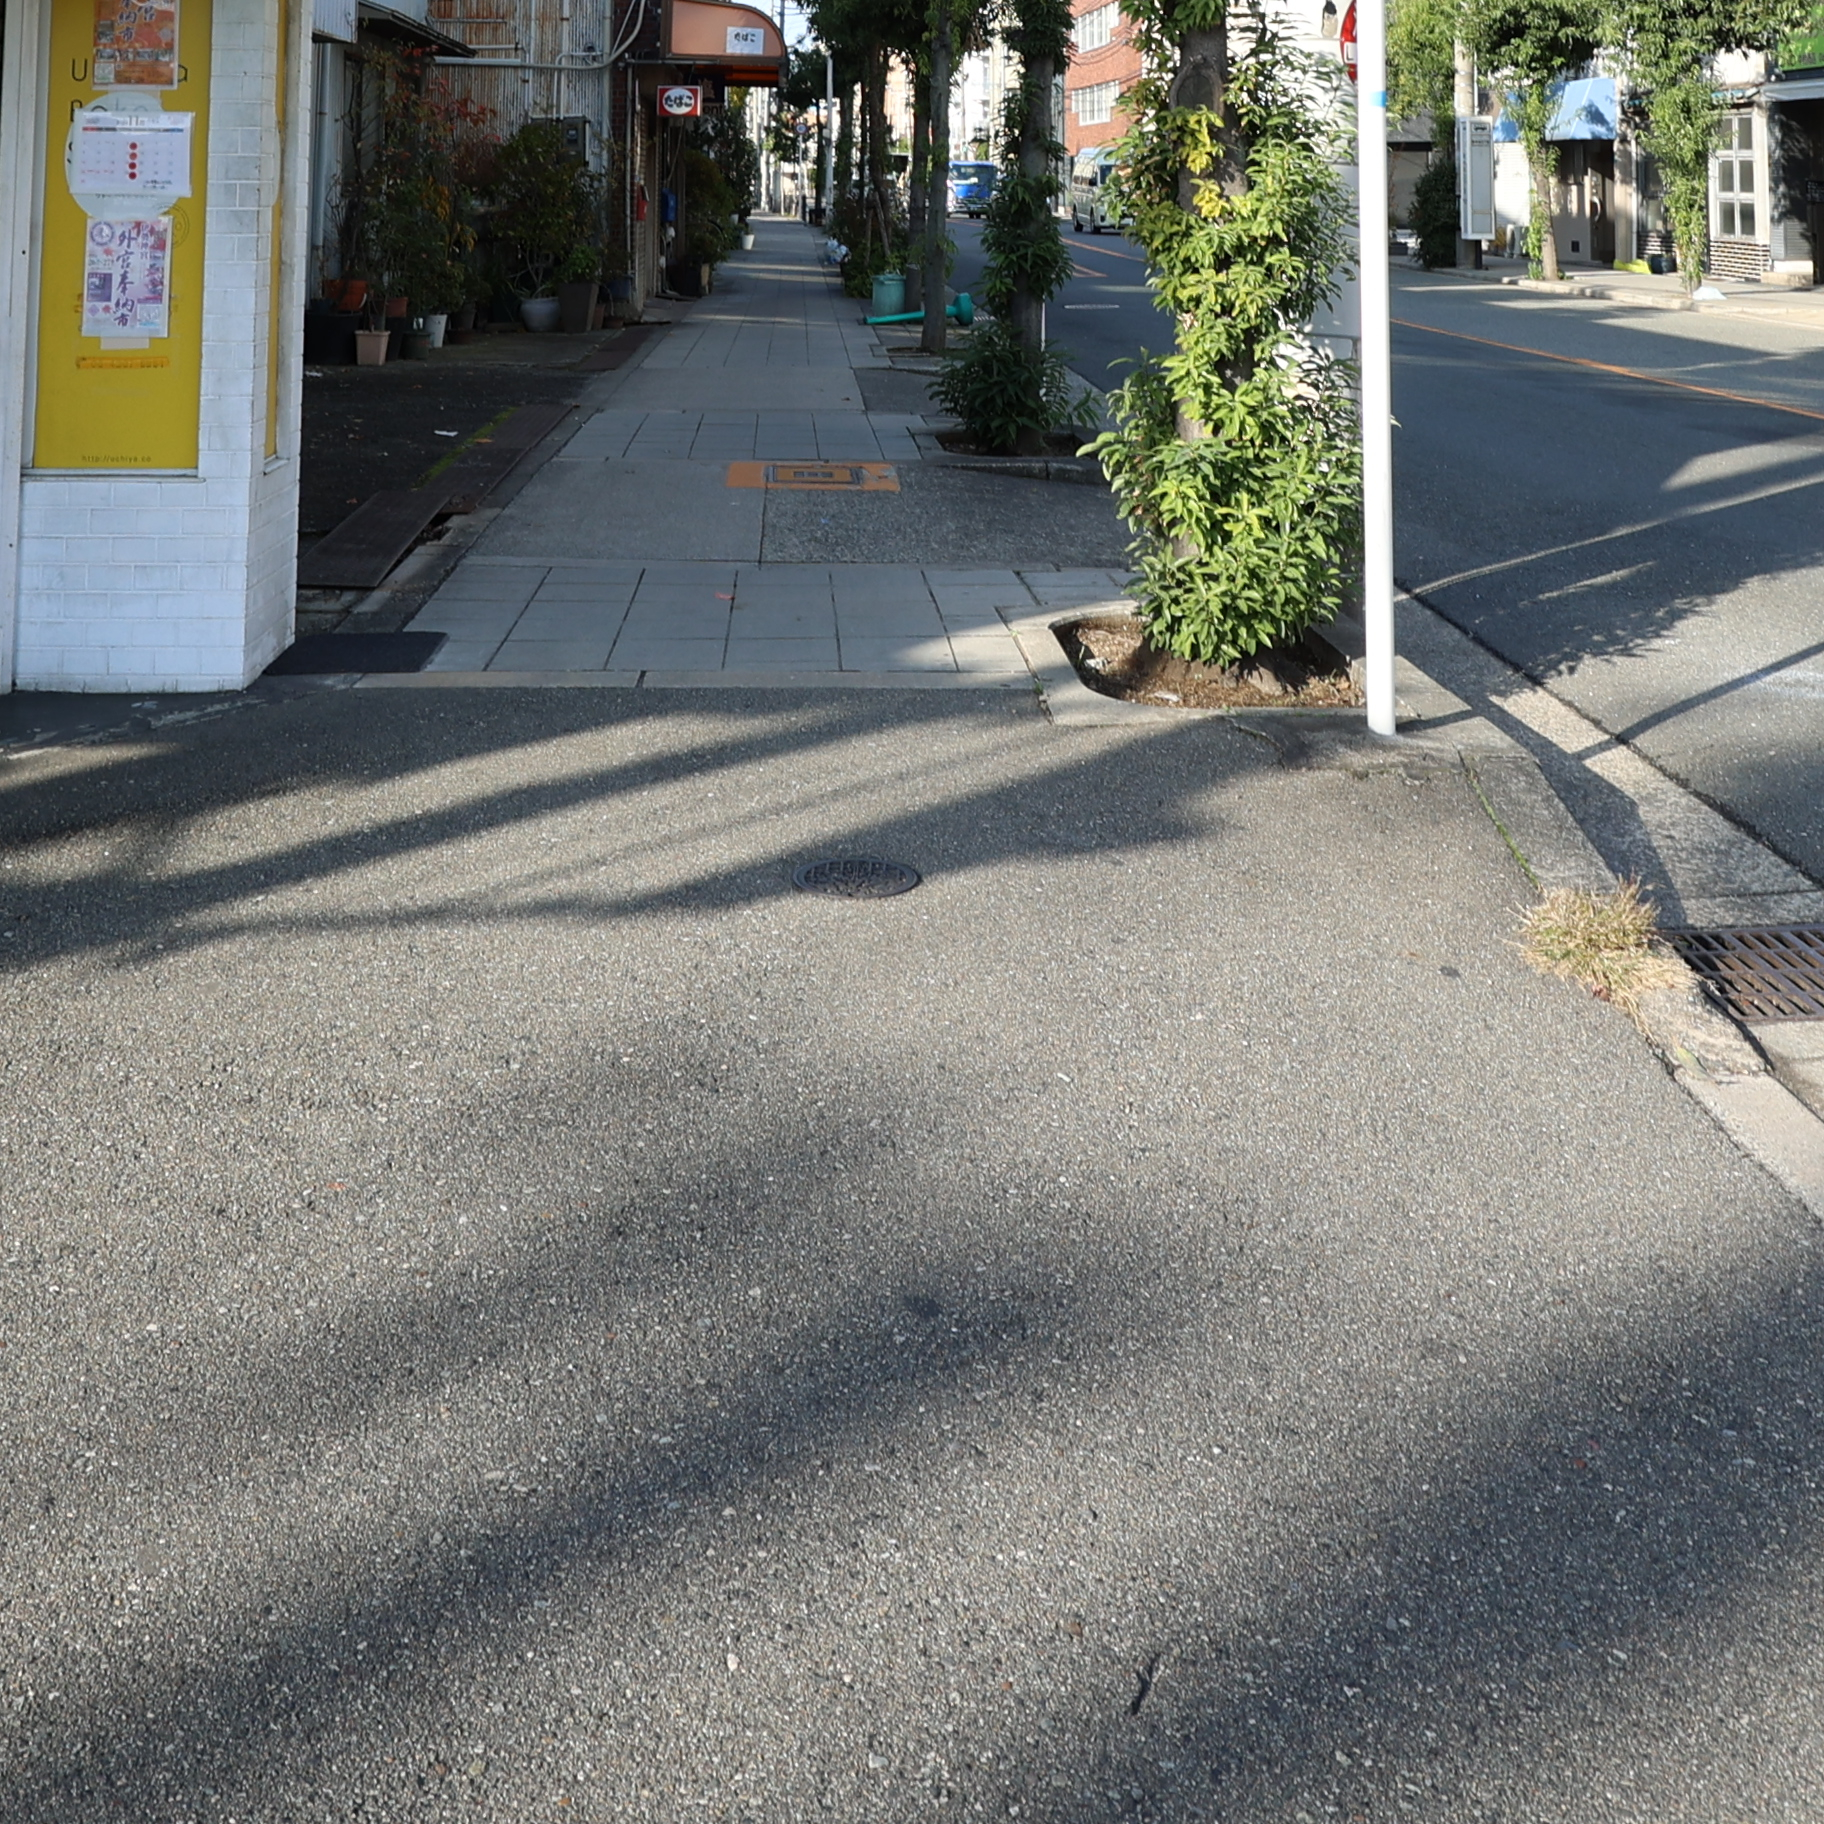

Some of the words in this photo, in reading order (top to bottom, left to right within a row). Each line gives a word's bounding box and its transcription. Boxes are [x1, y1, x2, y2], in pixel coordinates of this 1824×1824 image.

[734, 32, 756, 43] たばこ
[664, 93, 693, 108] たばこ
